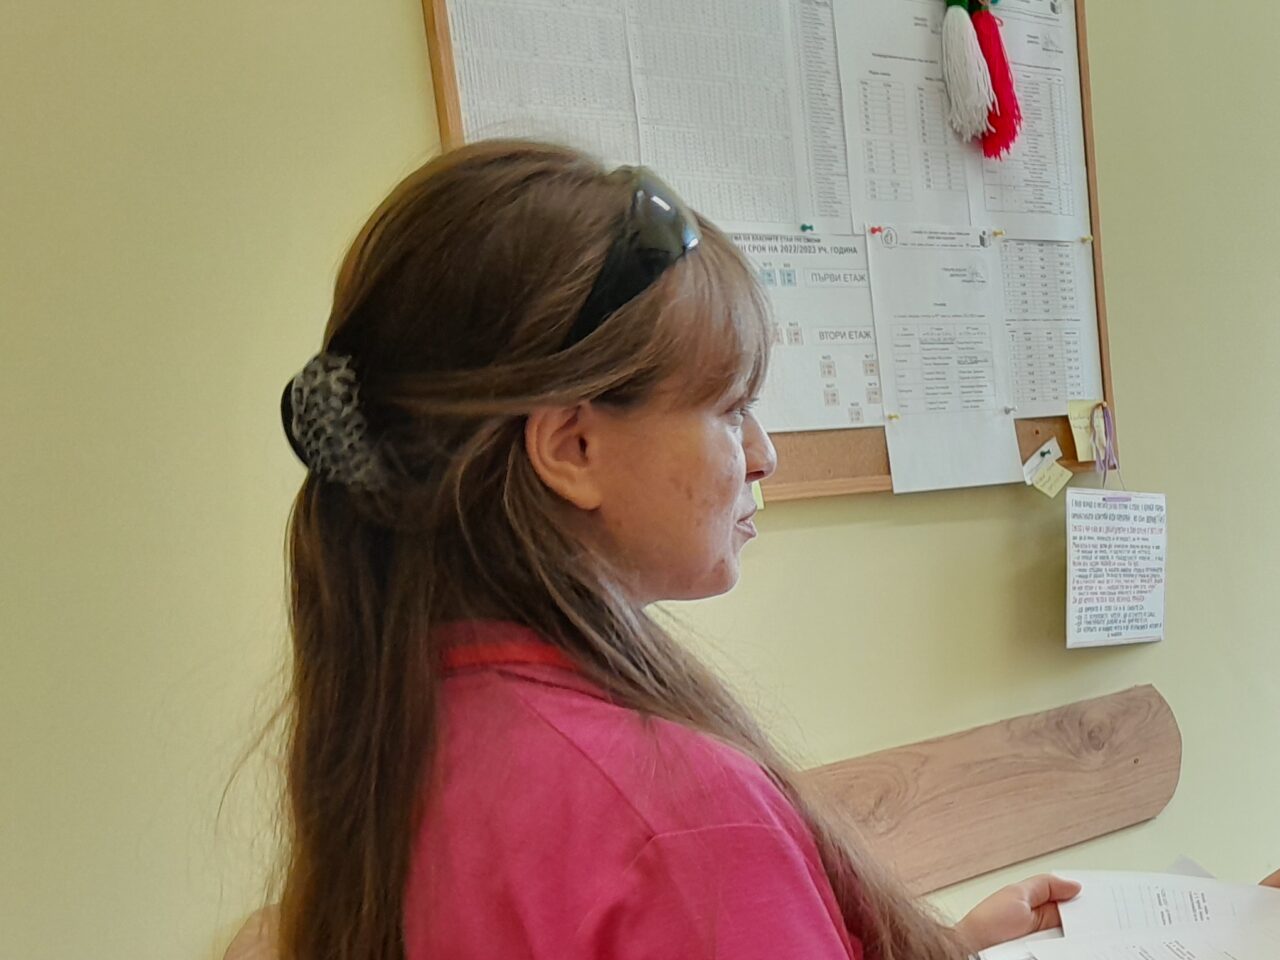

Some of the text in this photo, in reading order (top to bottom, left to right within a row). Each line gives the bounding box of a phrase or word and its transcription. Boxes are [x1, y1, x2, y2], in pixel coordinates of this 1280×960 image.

[748, 244, 766, 253] СРОК
[768, 244, 779, 253] НА
[780, 245, 817, 254] 2022/2023
[818, 246, 829, 254] УЧ.
[830, 246, 858, 255] ГОДИНА
[810, 272, 867, 283] ПЪРВИ ЕТАЖ
[818, 330, 872, 341] ВТОРИ ЕТАЖ
